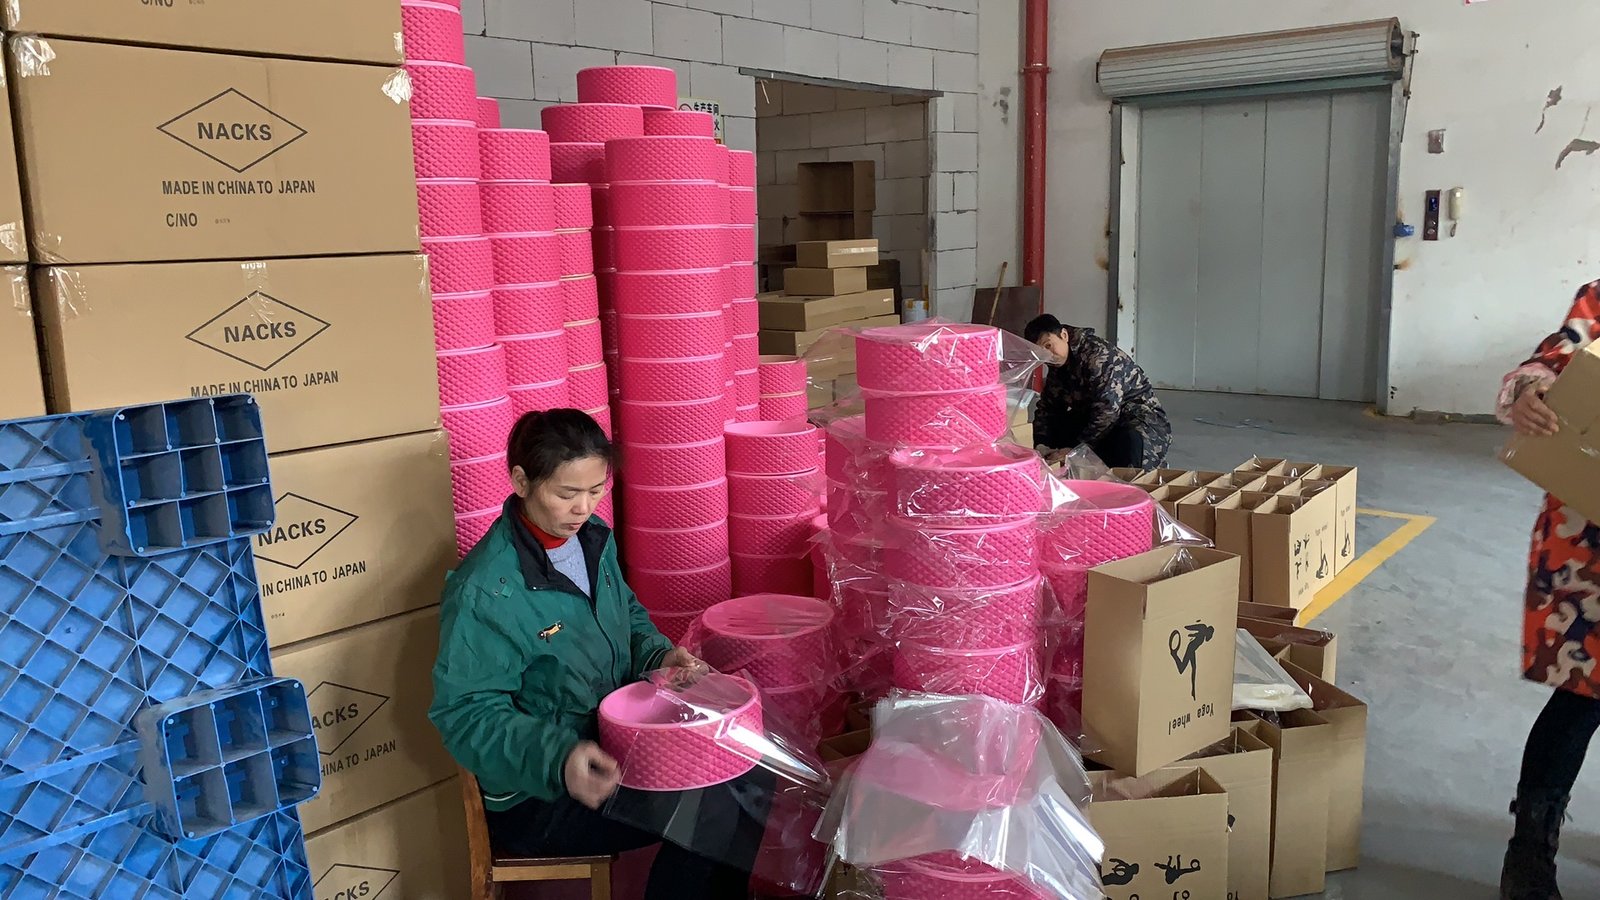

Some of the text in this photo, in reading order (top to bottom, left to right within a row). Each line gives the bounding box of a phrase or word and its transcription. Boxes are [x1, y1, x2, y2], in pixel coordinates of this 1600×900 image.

[197, 121, 273, 142] NACKS
[162, 180, 315, 195] MADE IN CHINA TO JAPAN
[166, 212, 198, 228] C/NO
[224, 321, 297, 344] NACKS
[190, 370, 339, 398] MADE IN CHINA TO JAPAN
[258, 518, 327, 547] NACKS
[262, 560, 367, 597] IN CHINA TO JAPAN
[312, 703, 359, 729] ACKS
[1168, 702, 1214, 735] Yoga wheel
[321, 740, 396, 777] HINA TO JAPAN
[325, 881, 370, 900] CKS
